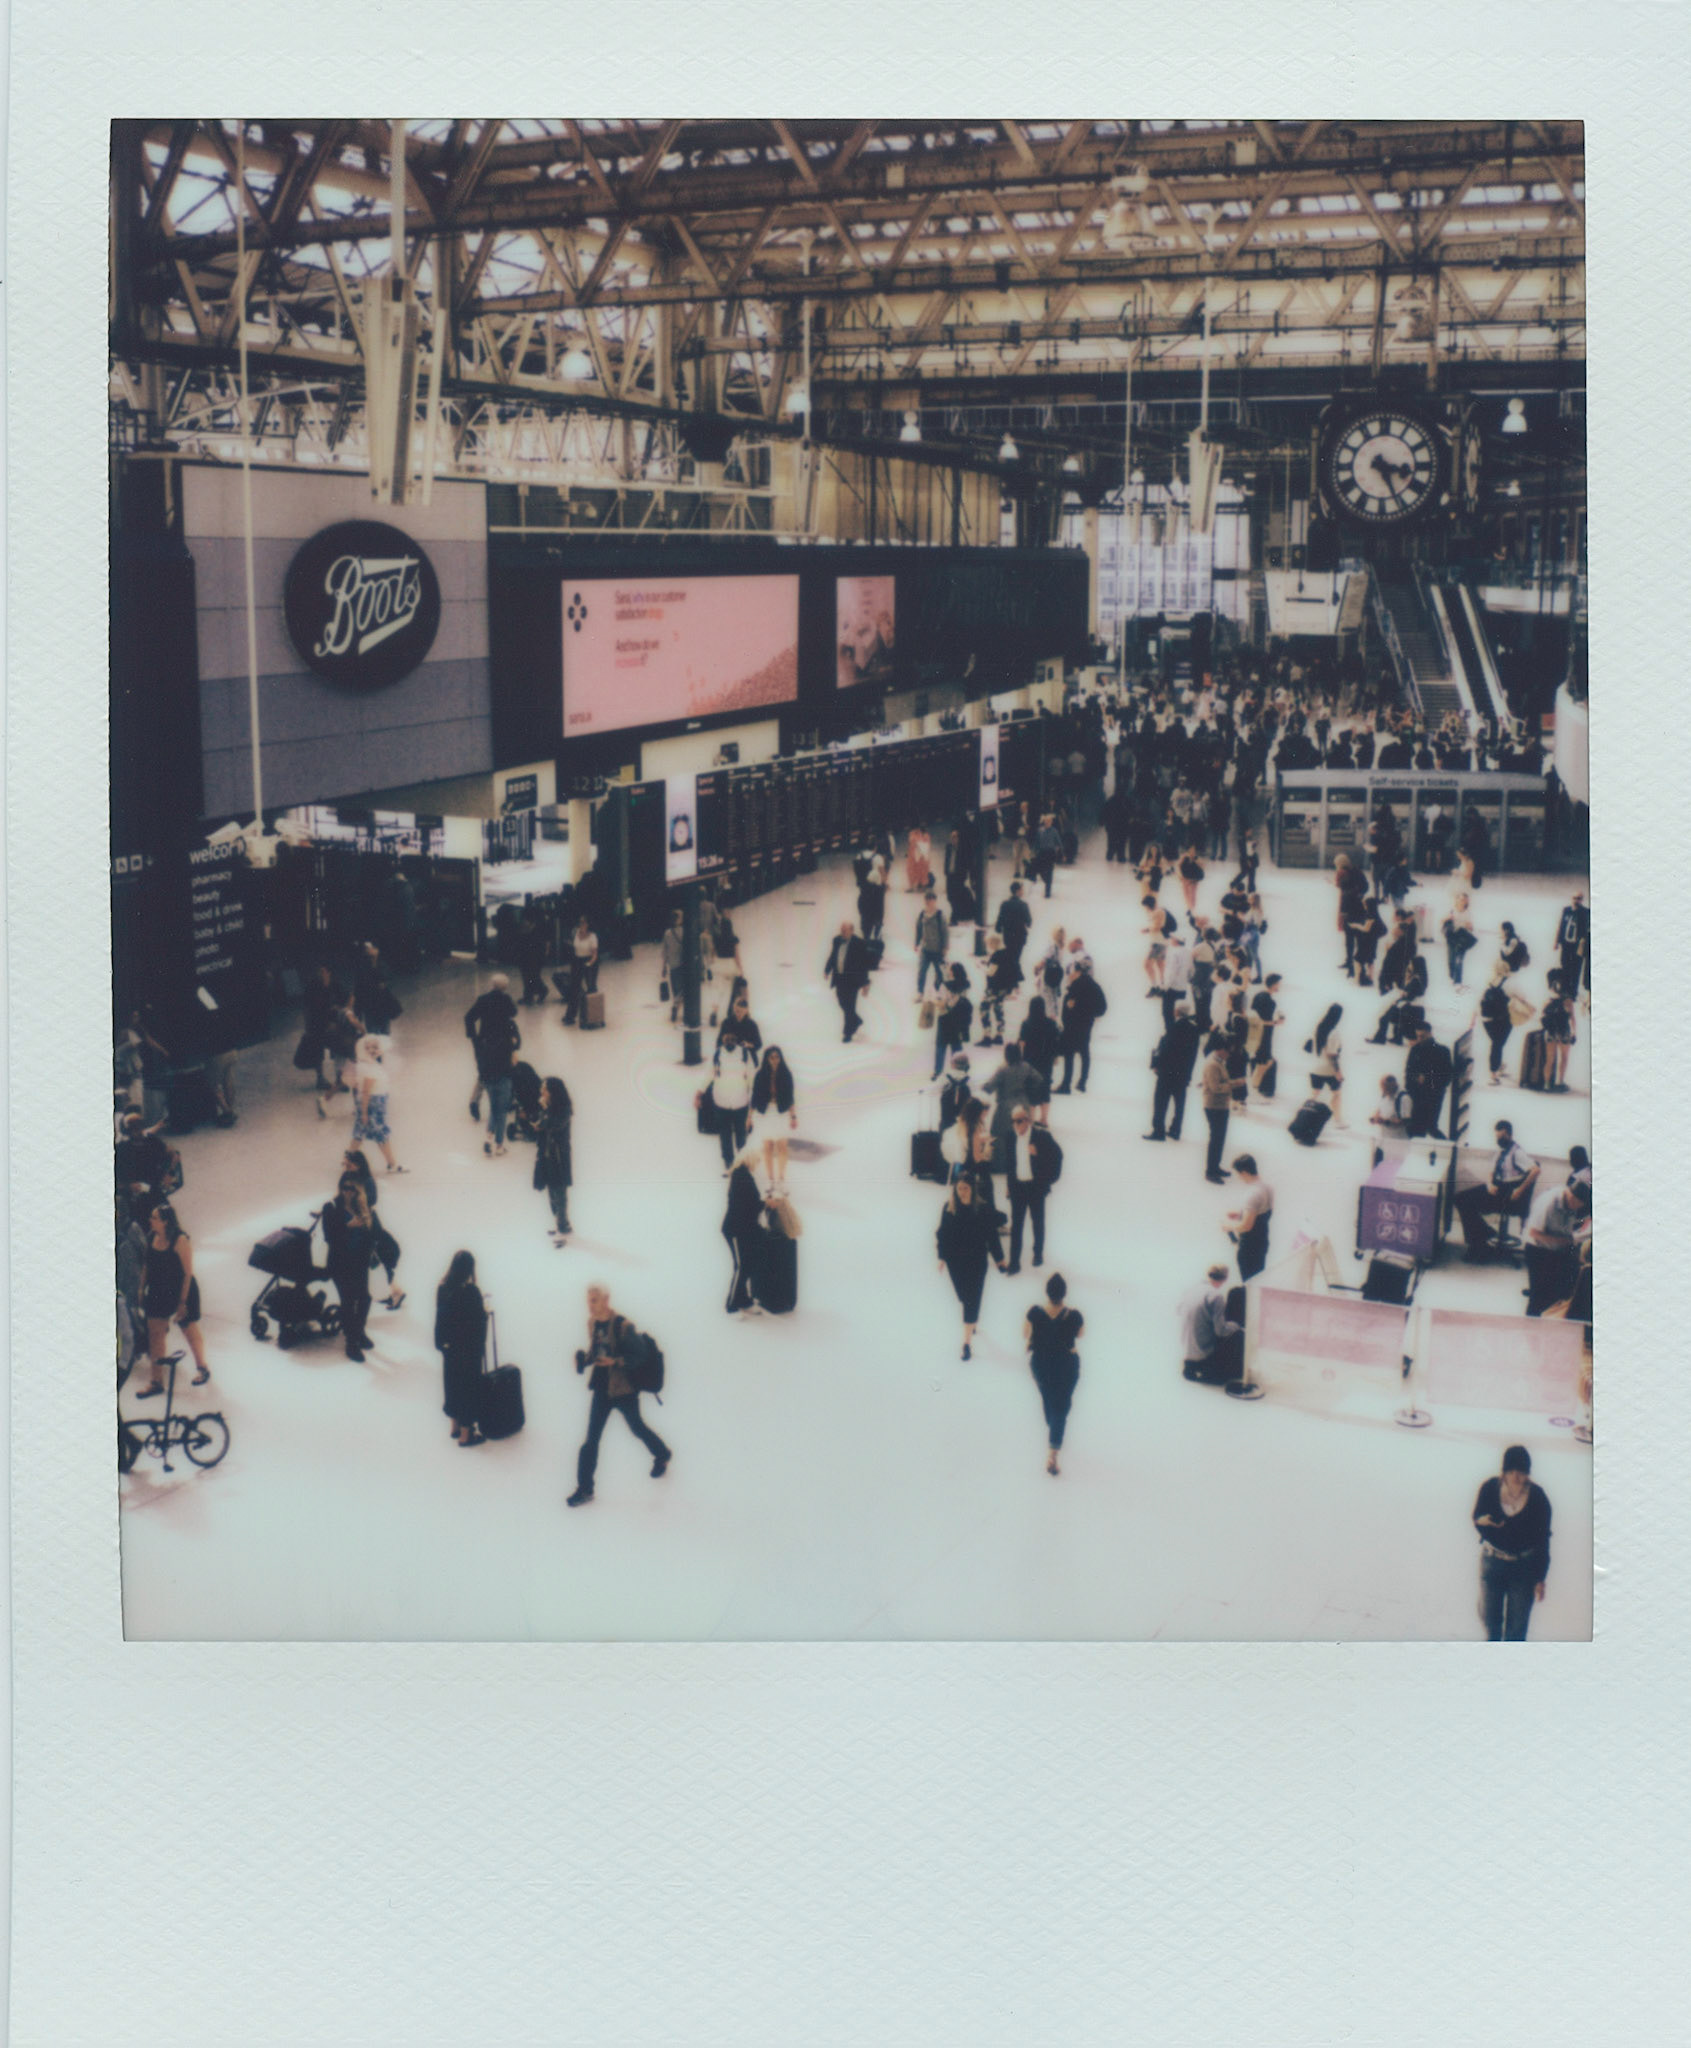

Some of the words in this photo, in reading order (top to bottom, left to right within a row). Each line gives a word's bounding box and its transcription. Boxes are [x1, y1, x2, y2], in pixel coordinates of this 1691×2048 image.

[313, 553, 422, 658] Boots
[1427, 777, 1459, 787] tickets
[189, 838, 244, 864] welcom
[191, 871, 233, 888] pharmacy
[192, 890, 221, 904] beauty
[193, 908, 213, 921] food
[222, 902, 243, 915] drink
[194, 927, 215, 940] baby
[224, 919, 245, 932] child
[195, 943, 220, 958] photo
[196, 957, 233, 975] electrical
